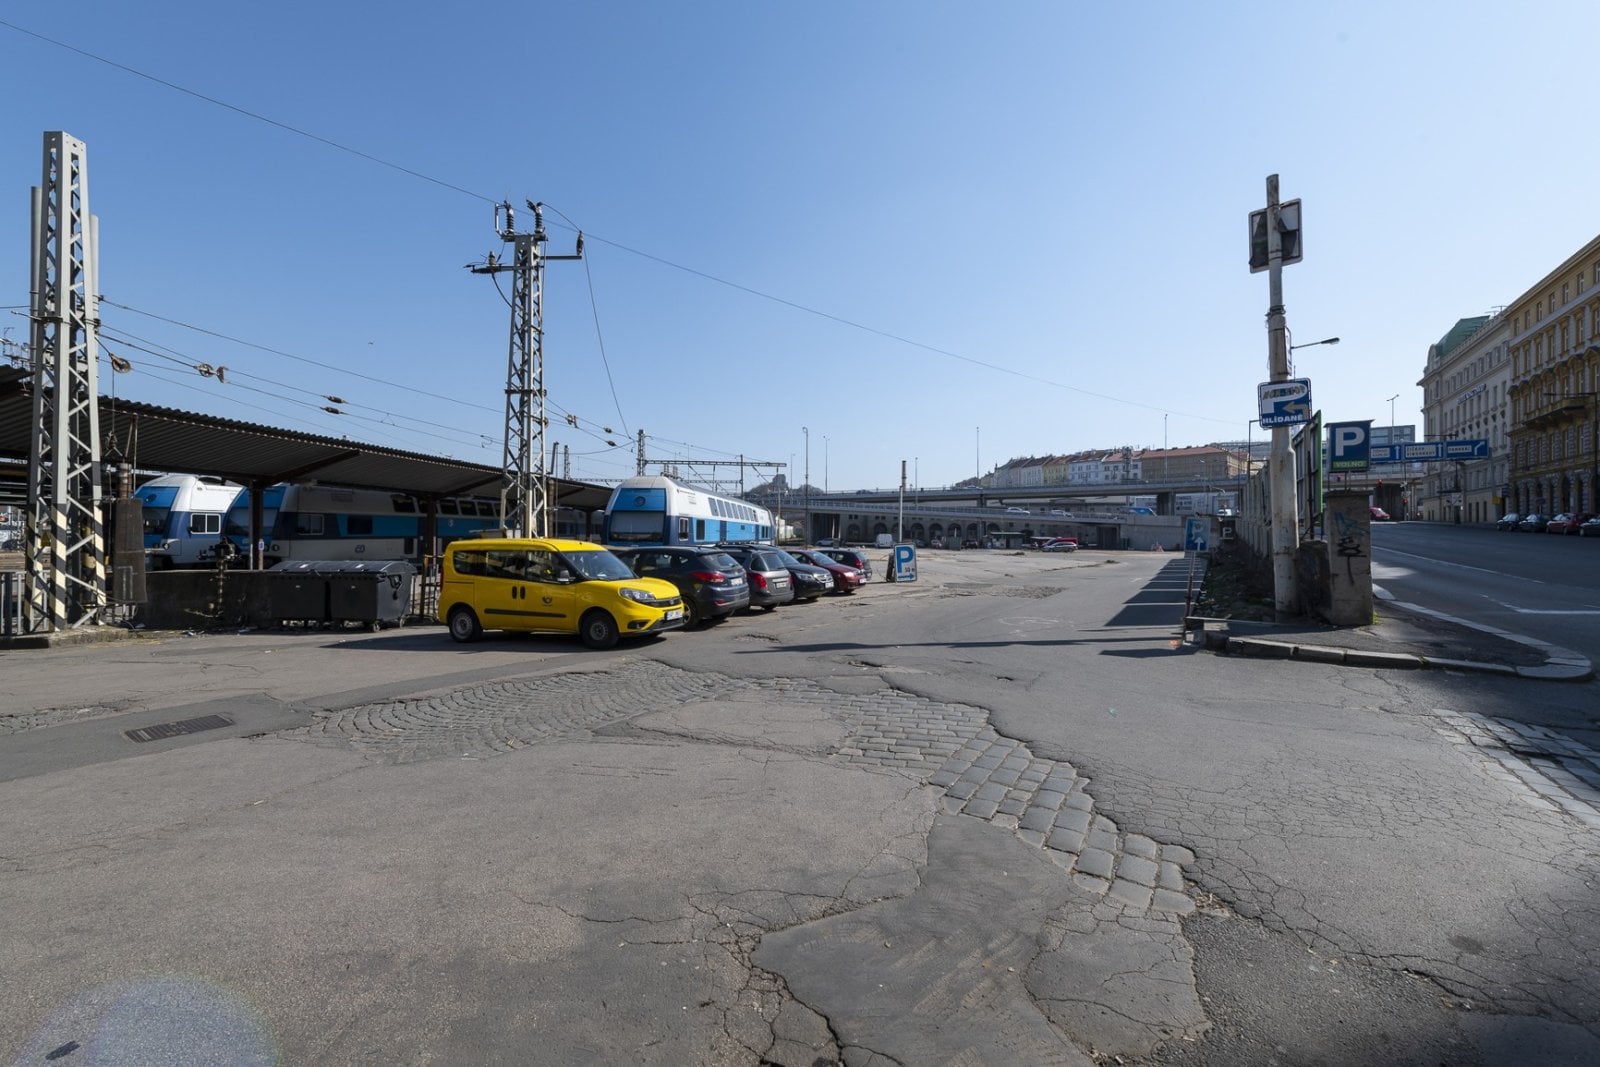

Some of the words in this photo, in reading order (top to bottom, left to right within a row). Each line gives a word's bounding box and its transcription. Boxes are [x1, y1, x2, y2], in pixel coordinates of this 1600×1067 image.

[1262, 413, 1303, 424] HLÍDANÉ
[1335, 426, 1365, 457] P
[1192, 521, 1205, 540] P
[1222, 527, 1233, 538] P
[896, 546, 914, 573] P
